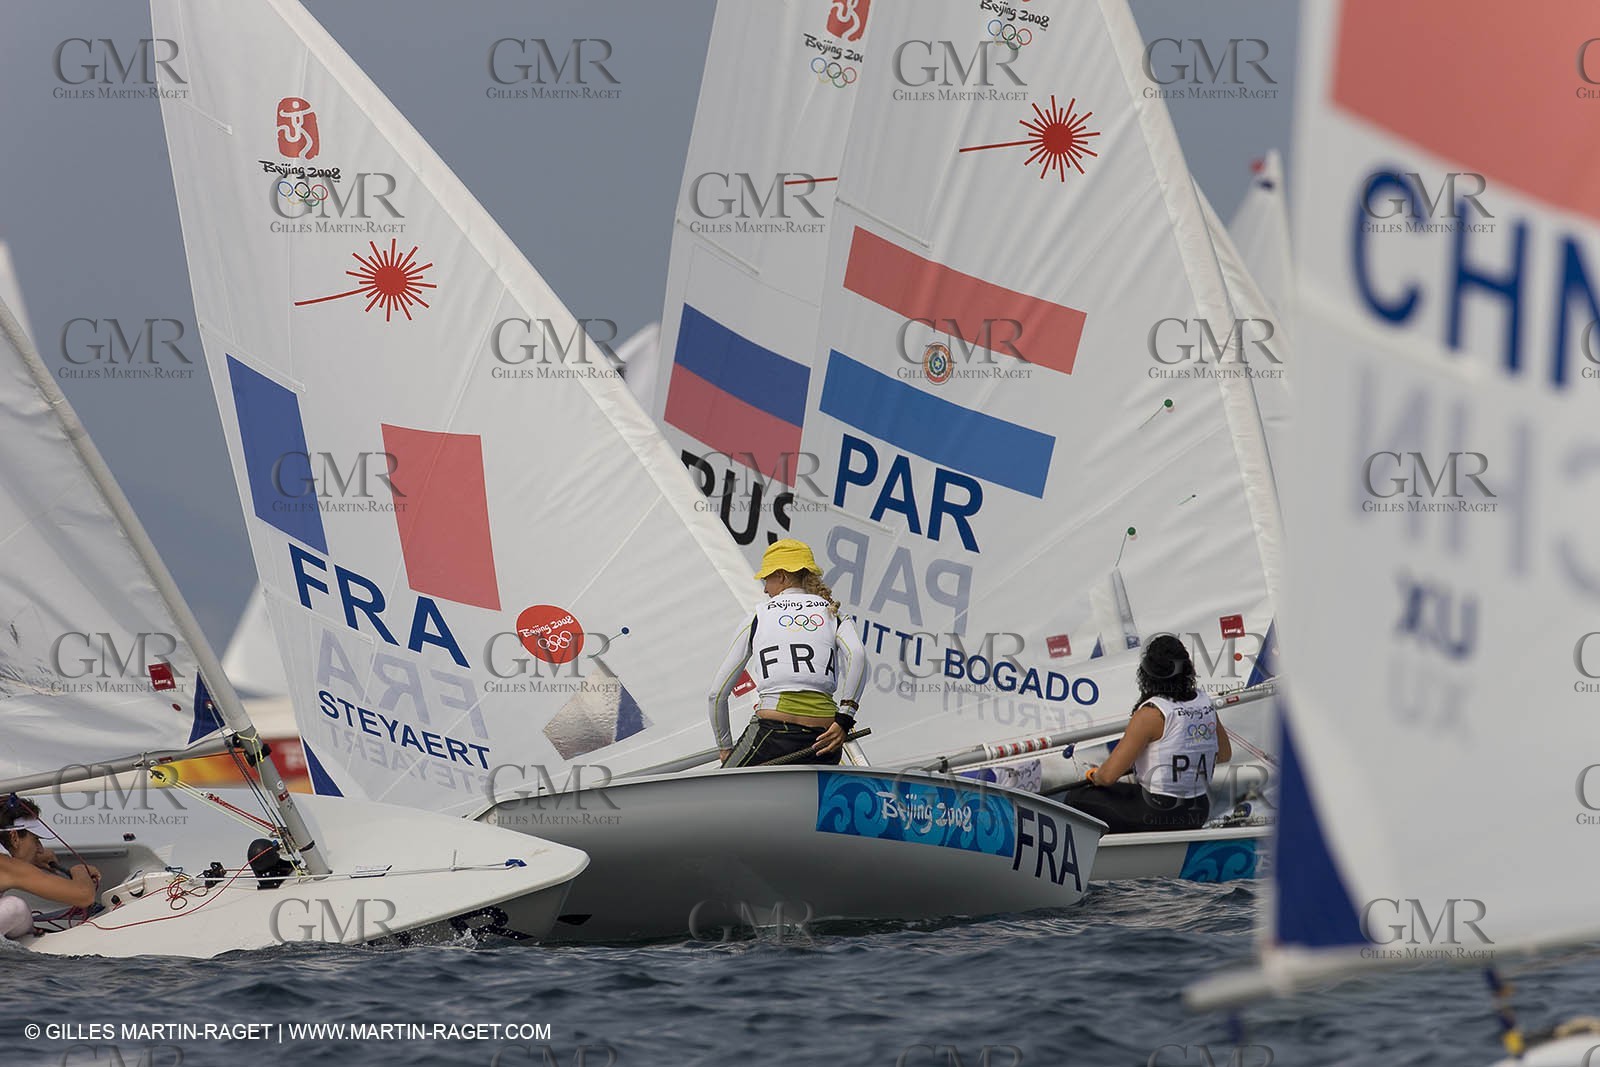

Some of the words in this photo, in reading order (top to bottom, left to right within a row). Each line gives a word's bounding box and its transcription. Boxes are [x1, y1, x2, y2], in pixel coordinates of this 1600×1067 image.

[1018, 10, 1050, 28] 2008
[803, 33, 843, 60] Beijing
[258, 160, 306, 180] Beijing
[307, 167, 342, 180] 2008
[1350, 164, 1600, 392] CHN
[833, 433, 984, 554] PAR
[287, 543, 471, 669] FRA
[767, 600, 803, 611] Beijing
[518, 624, 552, 640] Beijing
[551, 615, 575, 630] 2008
[759, 643, 837, 682] FRA
[944, 648, 1100, 706] BOGADO
[318, 690, 490, 770] STEYAERT
[1172, 752, 1218, 783] PA
[876, 791, 933, 834] Beijing
[935, 802, 972, 832] 2008
[1012, 806, 1082, 893] FRA
